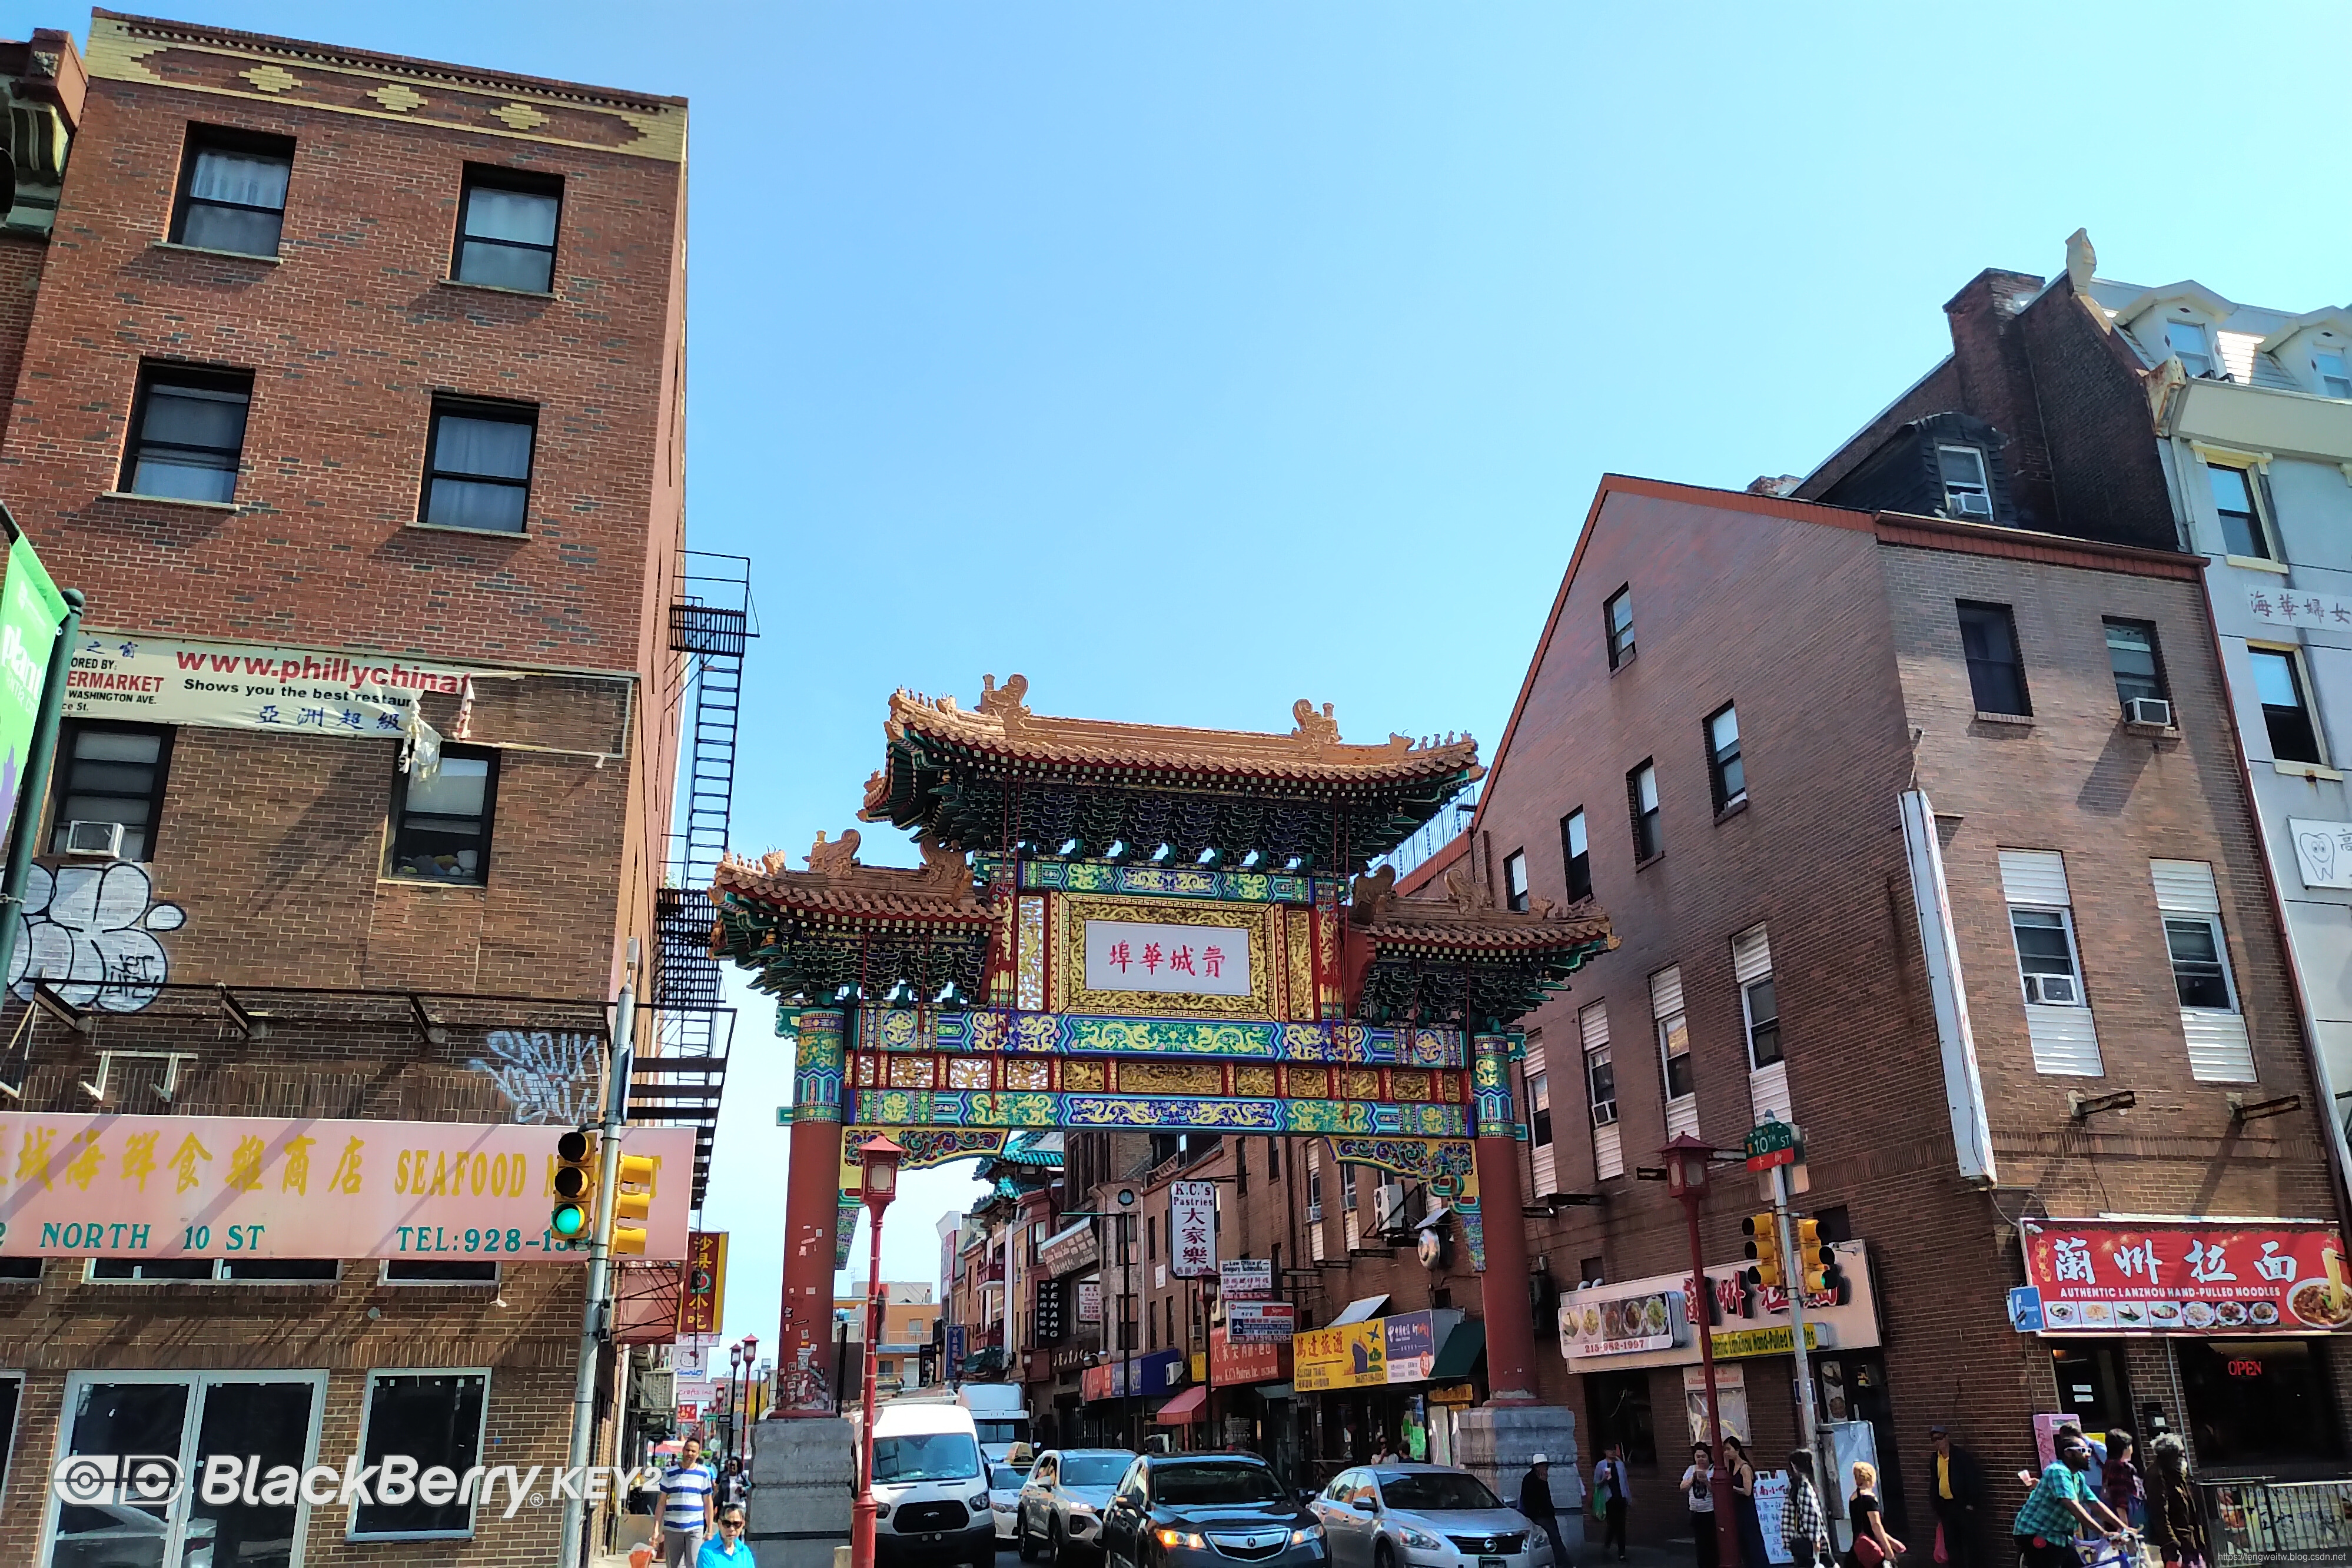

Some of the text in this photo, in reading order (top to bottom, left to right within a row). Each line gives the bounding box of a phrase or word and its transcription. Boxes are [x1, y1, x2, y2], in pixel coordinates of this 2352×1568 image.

[2250, 590, 2351, 624] 海華婦女
[71, 657, 98, 669] ORED
[67, 670, 164, 693] ERMARKET
[184, 678, 240, 693] Shows
[245, 685, 276, 698] you
[281, 687, 307, 699] the
[313, 688, 349, 702] best
[69, 690, 157, 705] WASHINGTON AVE.
[255, 705, 404, 732] 亞洲超級
[1780, 1135, 1789, 1147] ST
[394, 1148, 527, 1198] SEAFOOD
[1174, 1197, 1213, 1207] Pastries
[39, 1222, 151, 1250] NORTH
[183, 1225, 210, 1250] 10
[226, 1225, 266, 1250] ST
[1181, 1207, 1207, 1265] 大家樂
[2061, 1287, 2281, 1298] AUTHENTIC LANZHOU HAND-PULLED NOODLES
[1050, 1283, 1059, 1338] PENANG
[2228, 1361, 2262, 1376] OPEN
